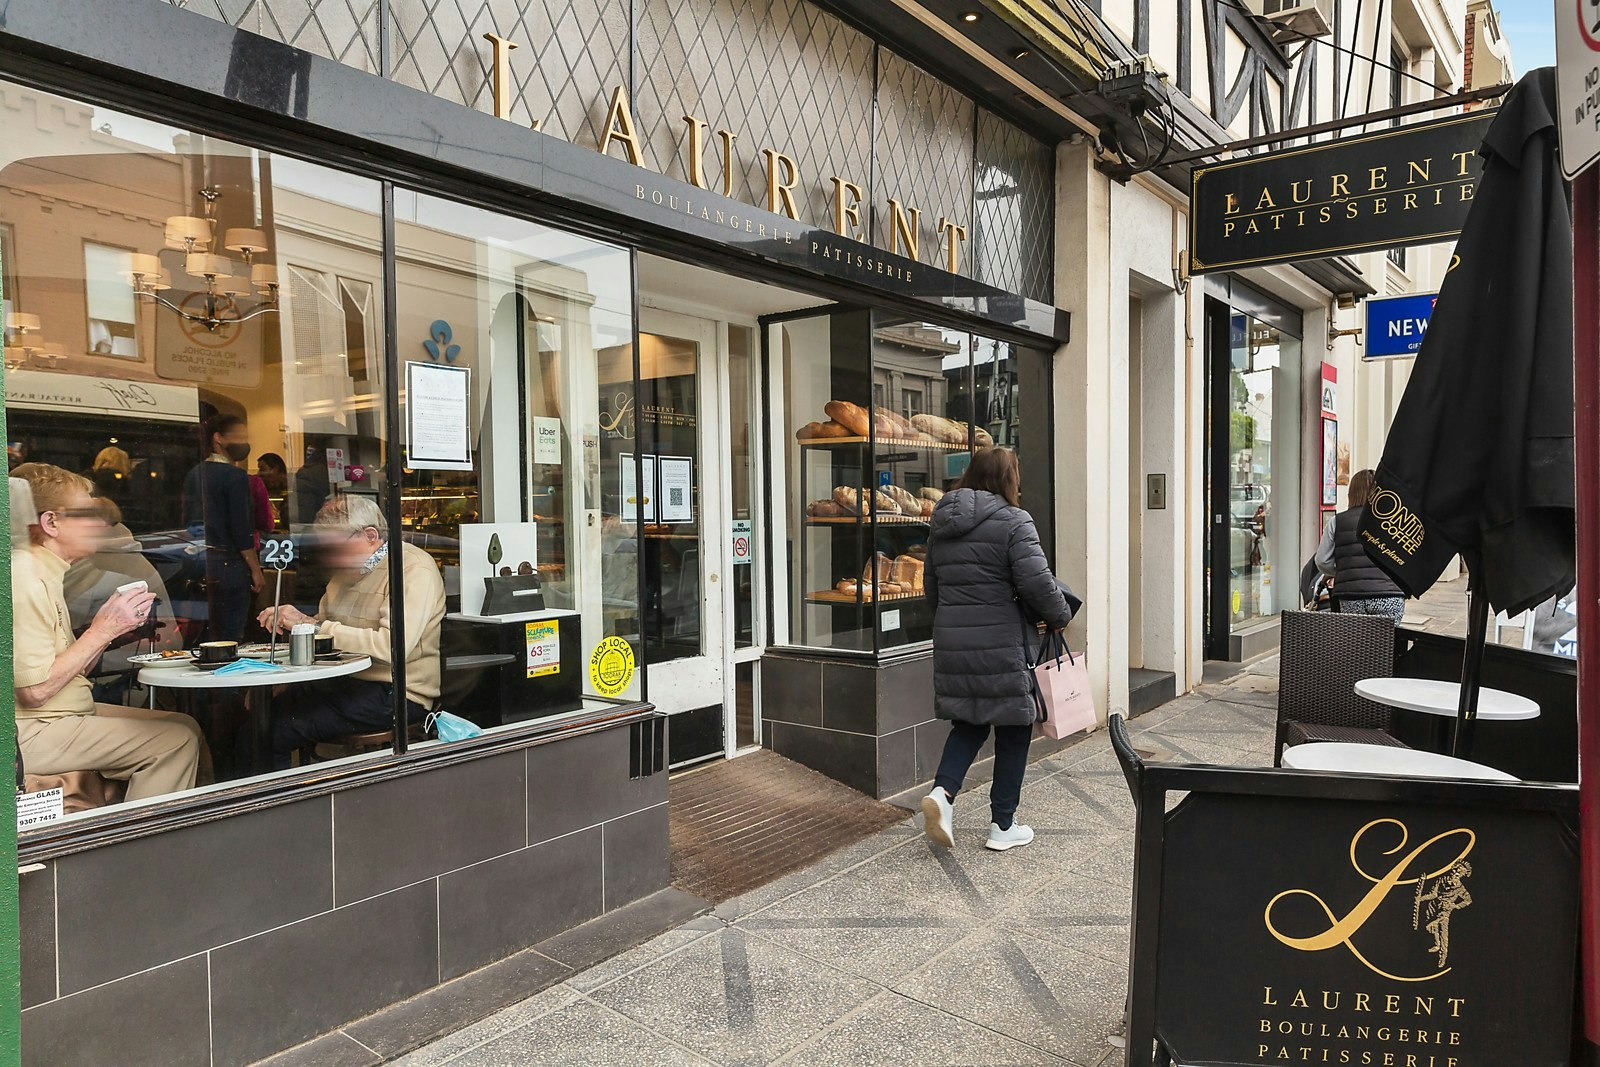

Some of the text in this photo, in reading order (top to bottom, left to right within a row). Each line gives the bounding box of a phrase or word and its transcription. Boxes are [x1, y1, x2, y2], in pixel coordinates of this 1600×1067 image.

[1585, 66, 1599, 92] NO
[1575, 103, 1585, 125] IN
[483, 33, 967, 274] LAURENT
[1224, 150, 1476, 215] LAURENT
[1223, 183, 1475, 238] PATISSERIE
[635, 184, 912, 283] BOULANGERIE PATISSERIE
[538, 427, 556, 436] Uber
[539, 436, 556, 445] Eats
[1380, 520, 1420, 556] COFFEE
[265, 539, 294, 562] 23
[1381, 549, 1406, 566] places
[530, 645, 543, 658] 63
[591, 638, 632, 665] SHOP LOCAL
[596, 681, 608, 694] keep
[608, 685, 623, 694] local
[36, 789, 61, 799] GLASS
[19, 817, 38, 826] 9307
[39, 813, 57, 822] 7412
[1262, 986, 1465, 1017] LAURENT
[1258, 1019, 1461, 1046] BOULANGERIE
[1257, 1044, 1459, 1067] PATISSERIE
